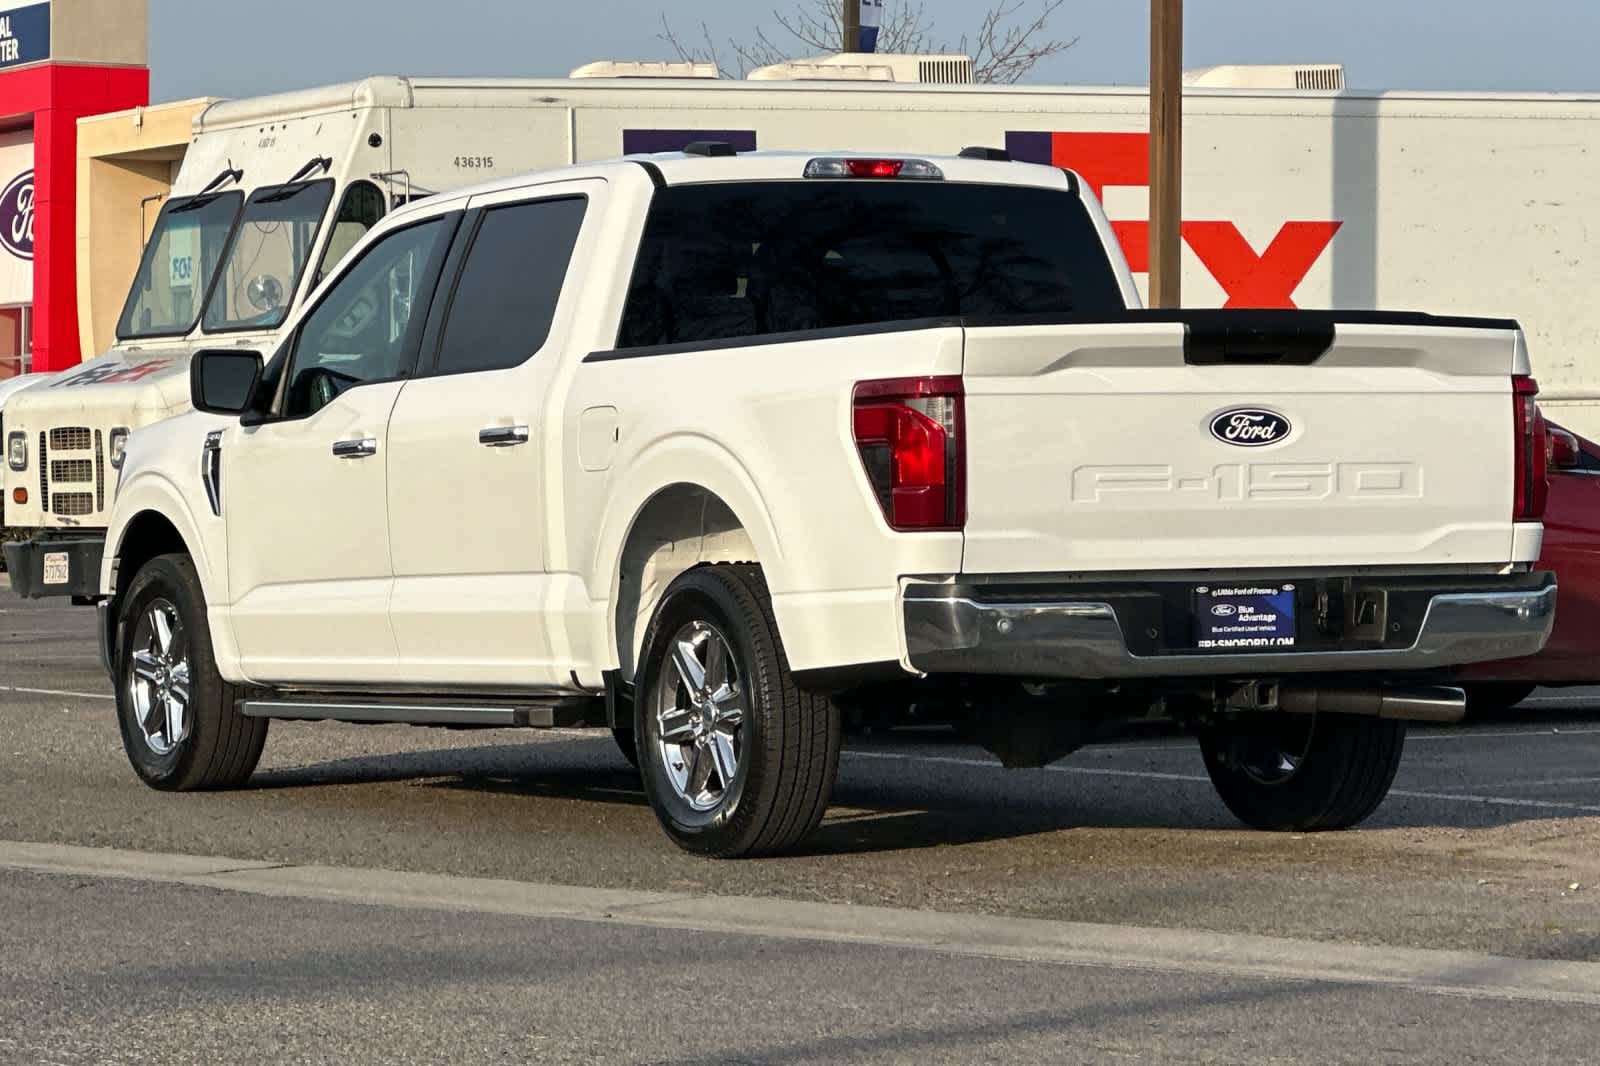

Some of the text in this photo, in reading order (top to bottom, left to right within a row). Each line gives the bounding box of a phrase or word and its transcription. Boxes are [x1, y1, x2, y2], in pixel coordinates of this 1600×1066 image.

[453, 156, 494, 168] 436315
[1225, 414, 1277, 439] Ford
[1072, 463, 1424, 503] F-150
[1238, 606, 1254, 614] Blue
[1238, 614, 1277, 623] Advantage
